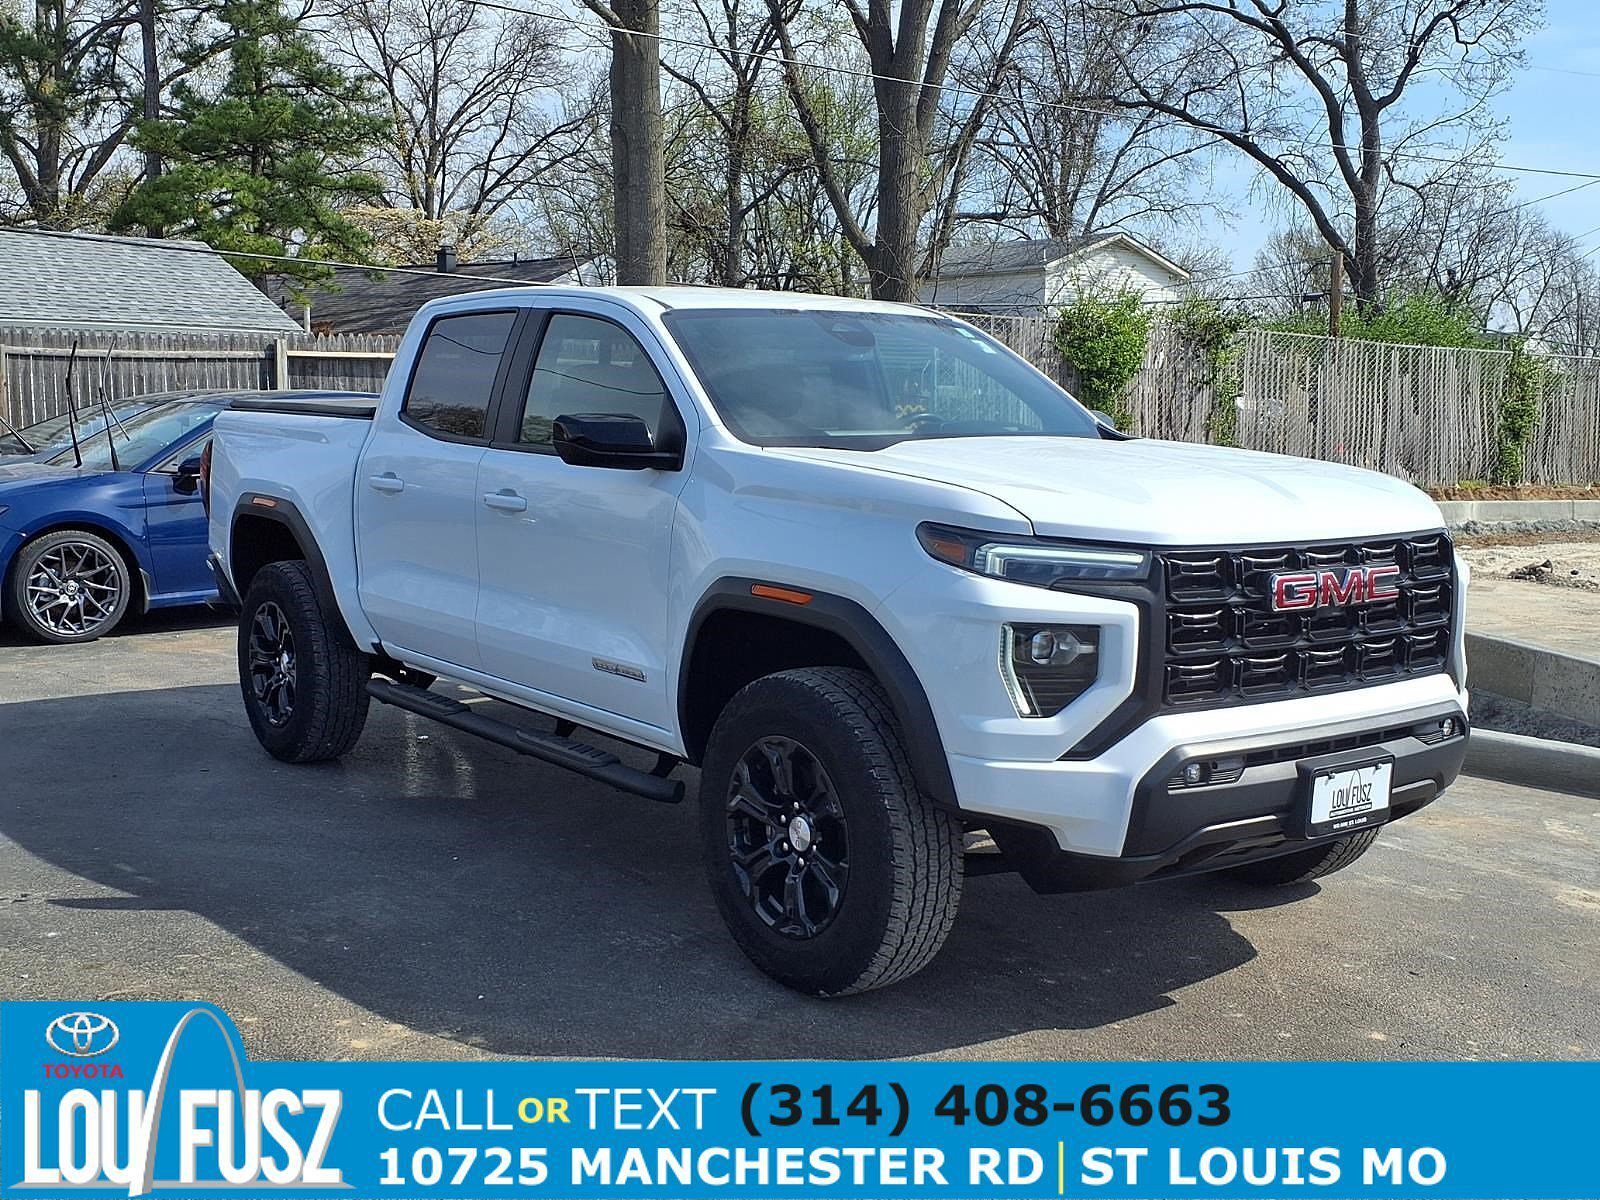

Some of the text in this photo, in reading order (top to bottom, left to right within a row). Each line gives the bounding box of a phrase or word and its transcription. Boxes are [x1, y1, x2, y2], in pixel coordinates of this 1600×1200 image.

[1270, 565, 1400, 612] GMC
[1331, 783, 1373, 809] LOU FUSZ
